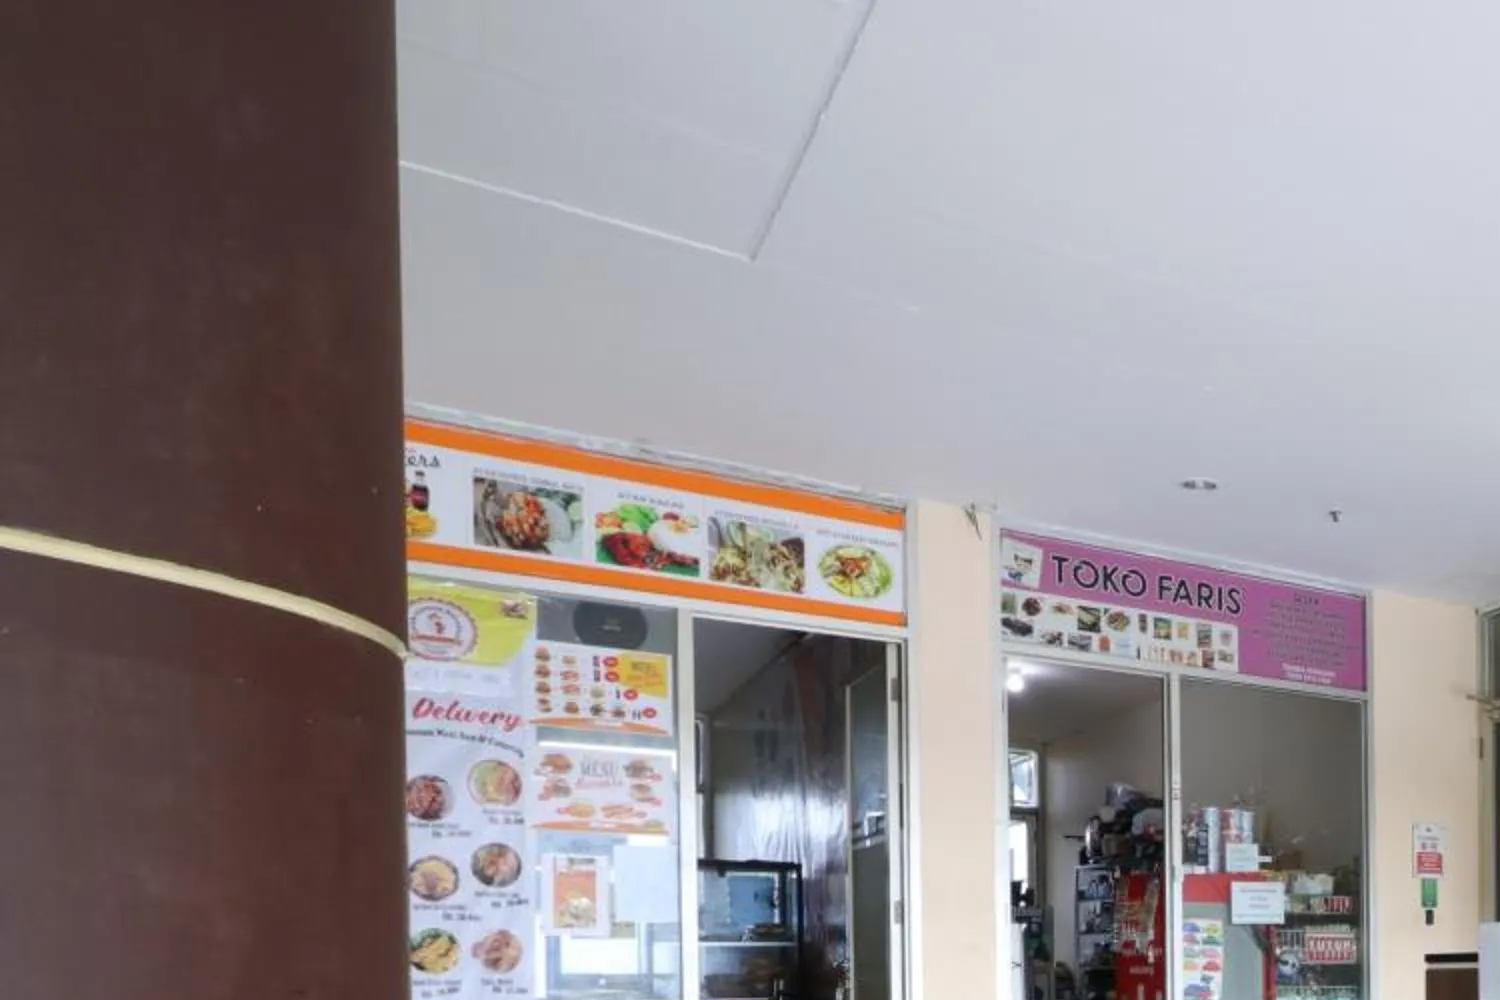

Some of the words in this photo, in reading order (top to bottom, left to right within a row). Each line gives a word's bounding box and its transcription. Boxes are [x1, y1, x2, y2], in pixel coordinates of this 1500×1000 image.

[1051, 555, 1148, 598] TOKO
[1157, 574, 1244, 615] FARIS
[412, 696, 522, 733] Delivery
